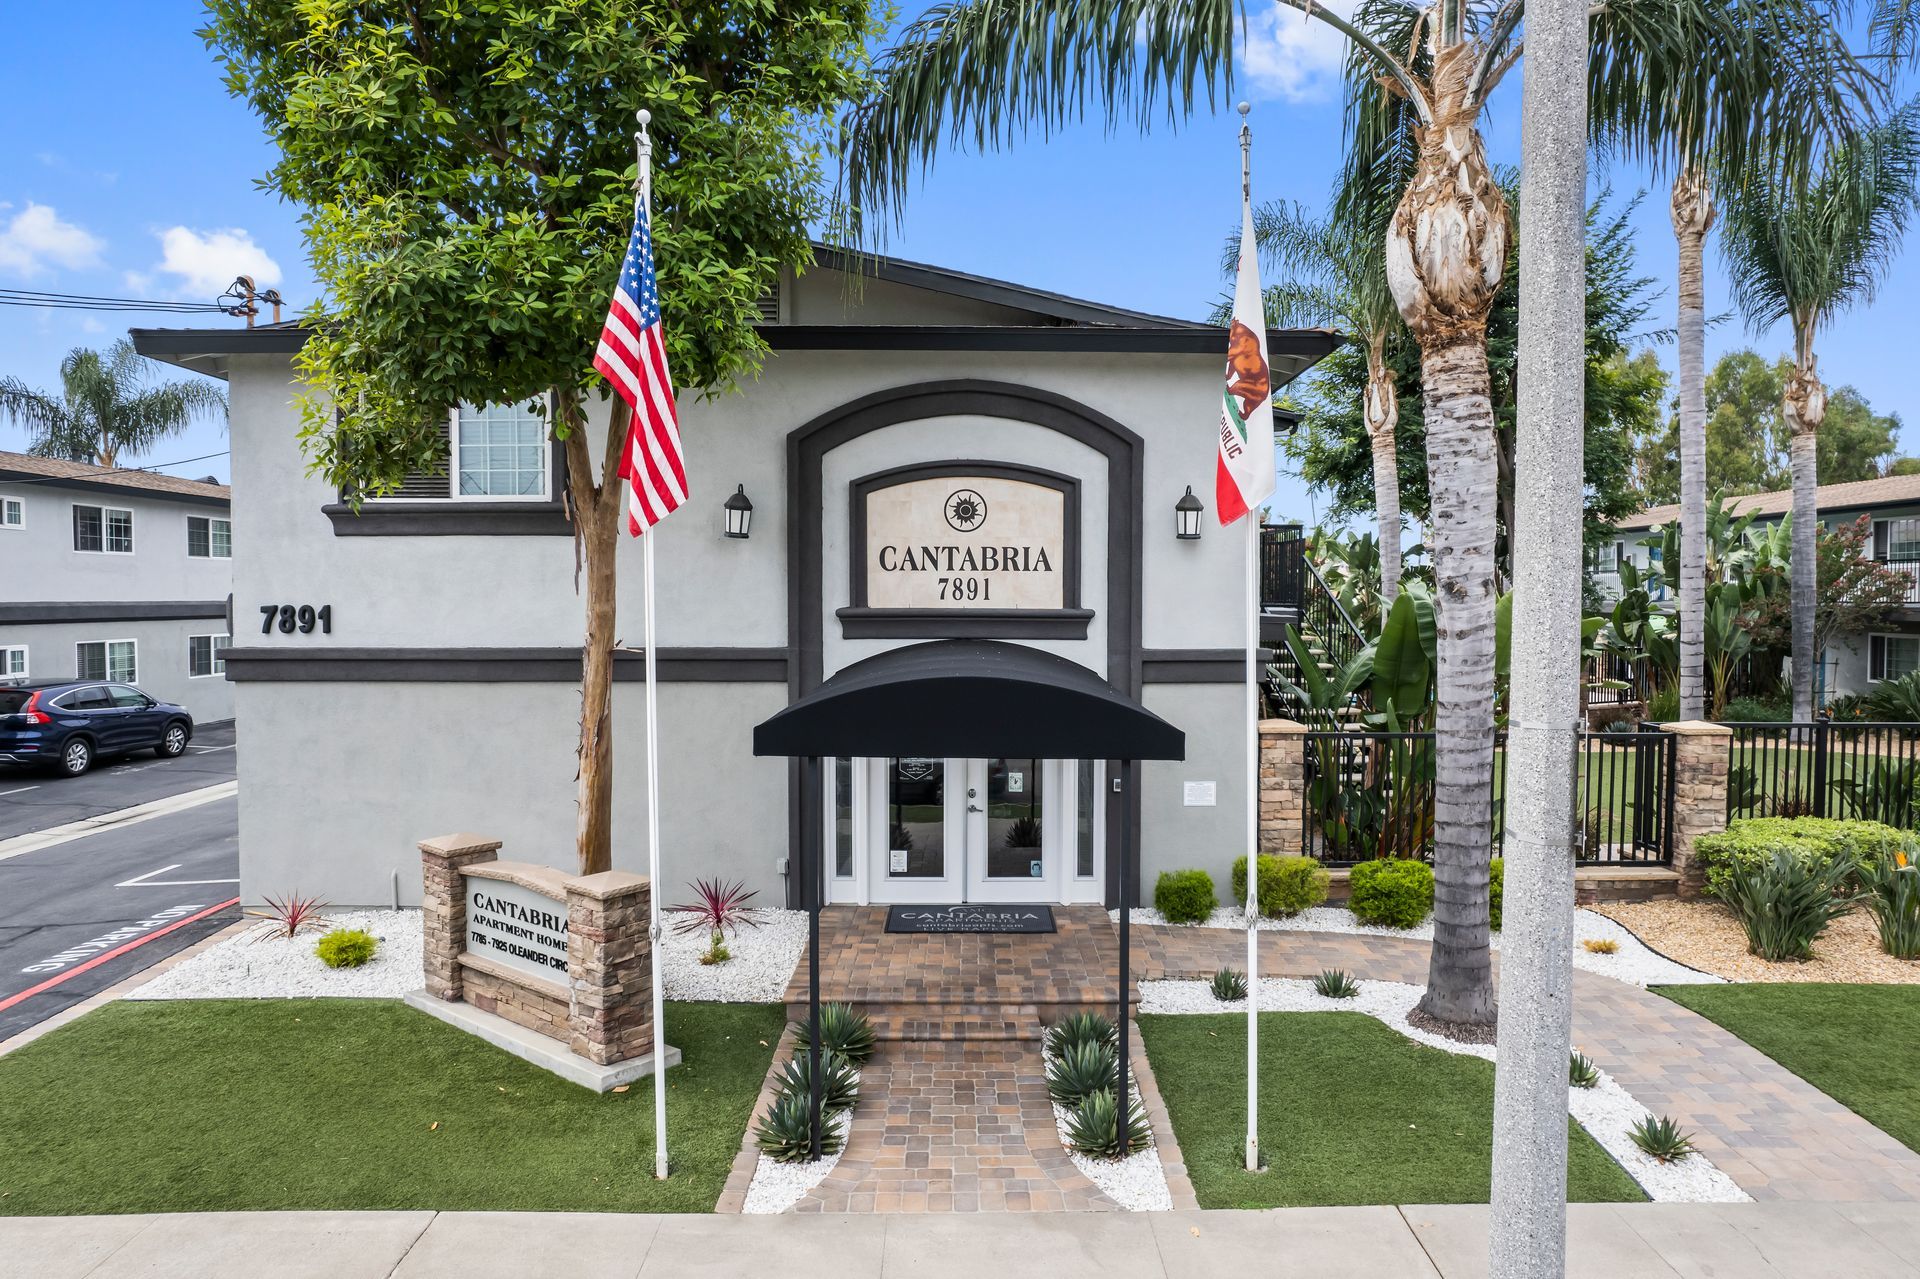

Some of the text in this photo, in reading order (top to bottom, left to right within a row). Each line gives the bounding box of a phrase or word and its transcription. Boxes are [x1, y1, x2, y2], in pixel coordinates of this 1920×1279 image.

[1221, 410, 1243, 459] PUBLIC
[879, 545, 1053, 572] CANTABRIA
[938, 577, 991, 601] 7891
[260, 604, 332, 634] 7891
[473, 892, 569, 934] CANTABRIA
[473, 913, 568, 953] APARTMENT HOME
[900, 912, 1040, 920] CANTABRIA
[22, 919, 170, 973] PARKING
[471, 931, 487, 945] 7785
[491, 937, 508, 953] 7925
[508, 943, 549, 967] OLEANDER
[549, 956, 569, 973] CIRC
